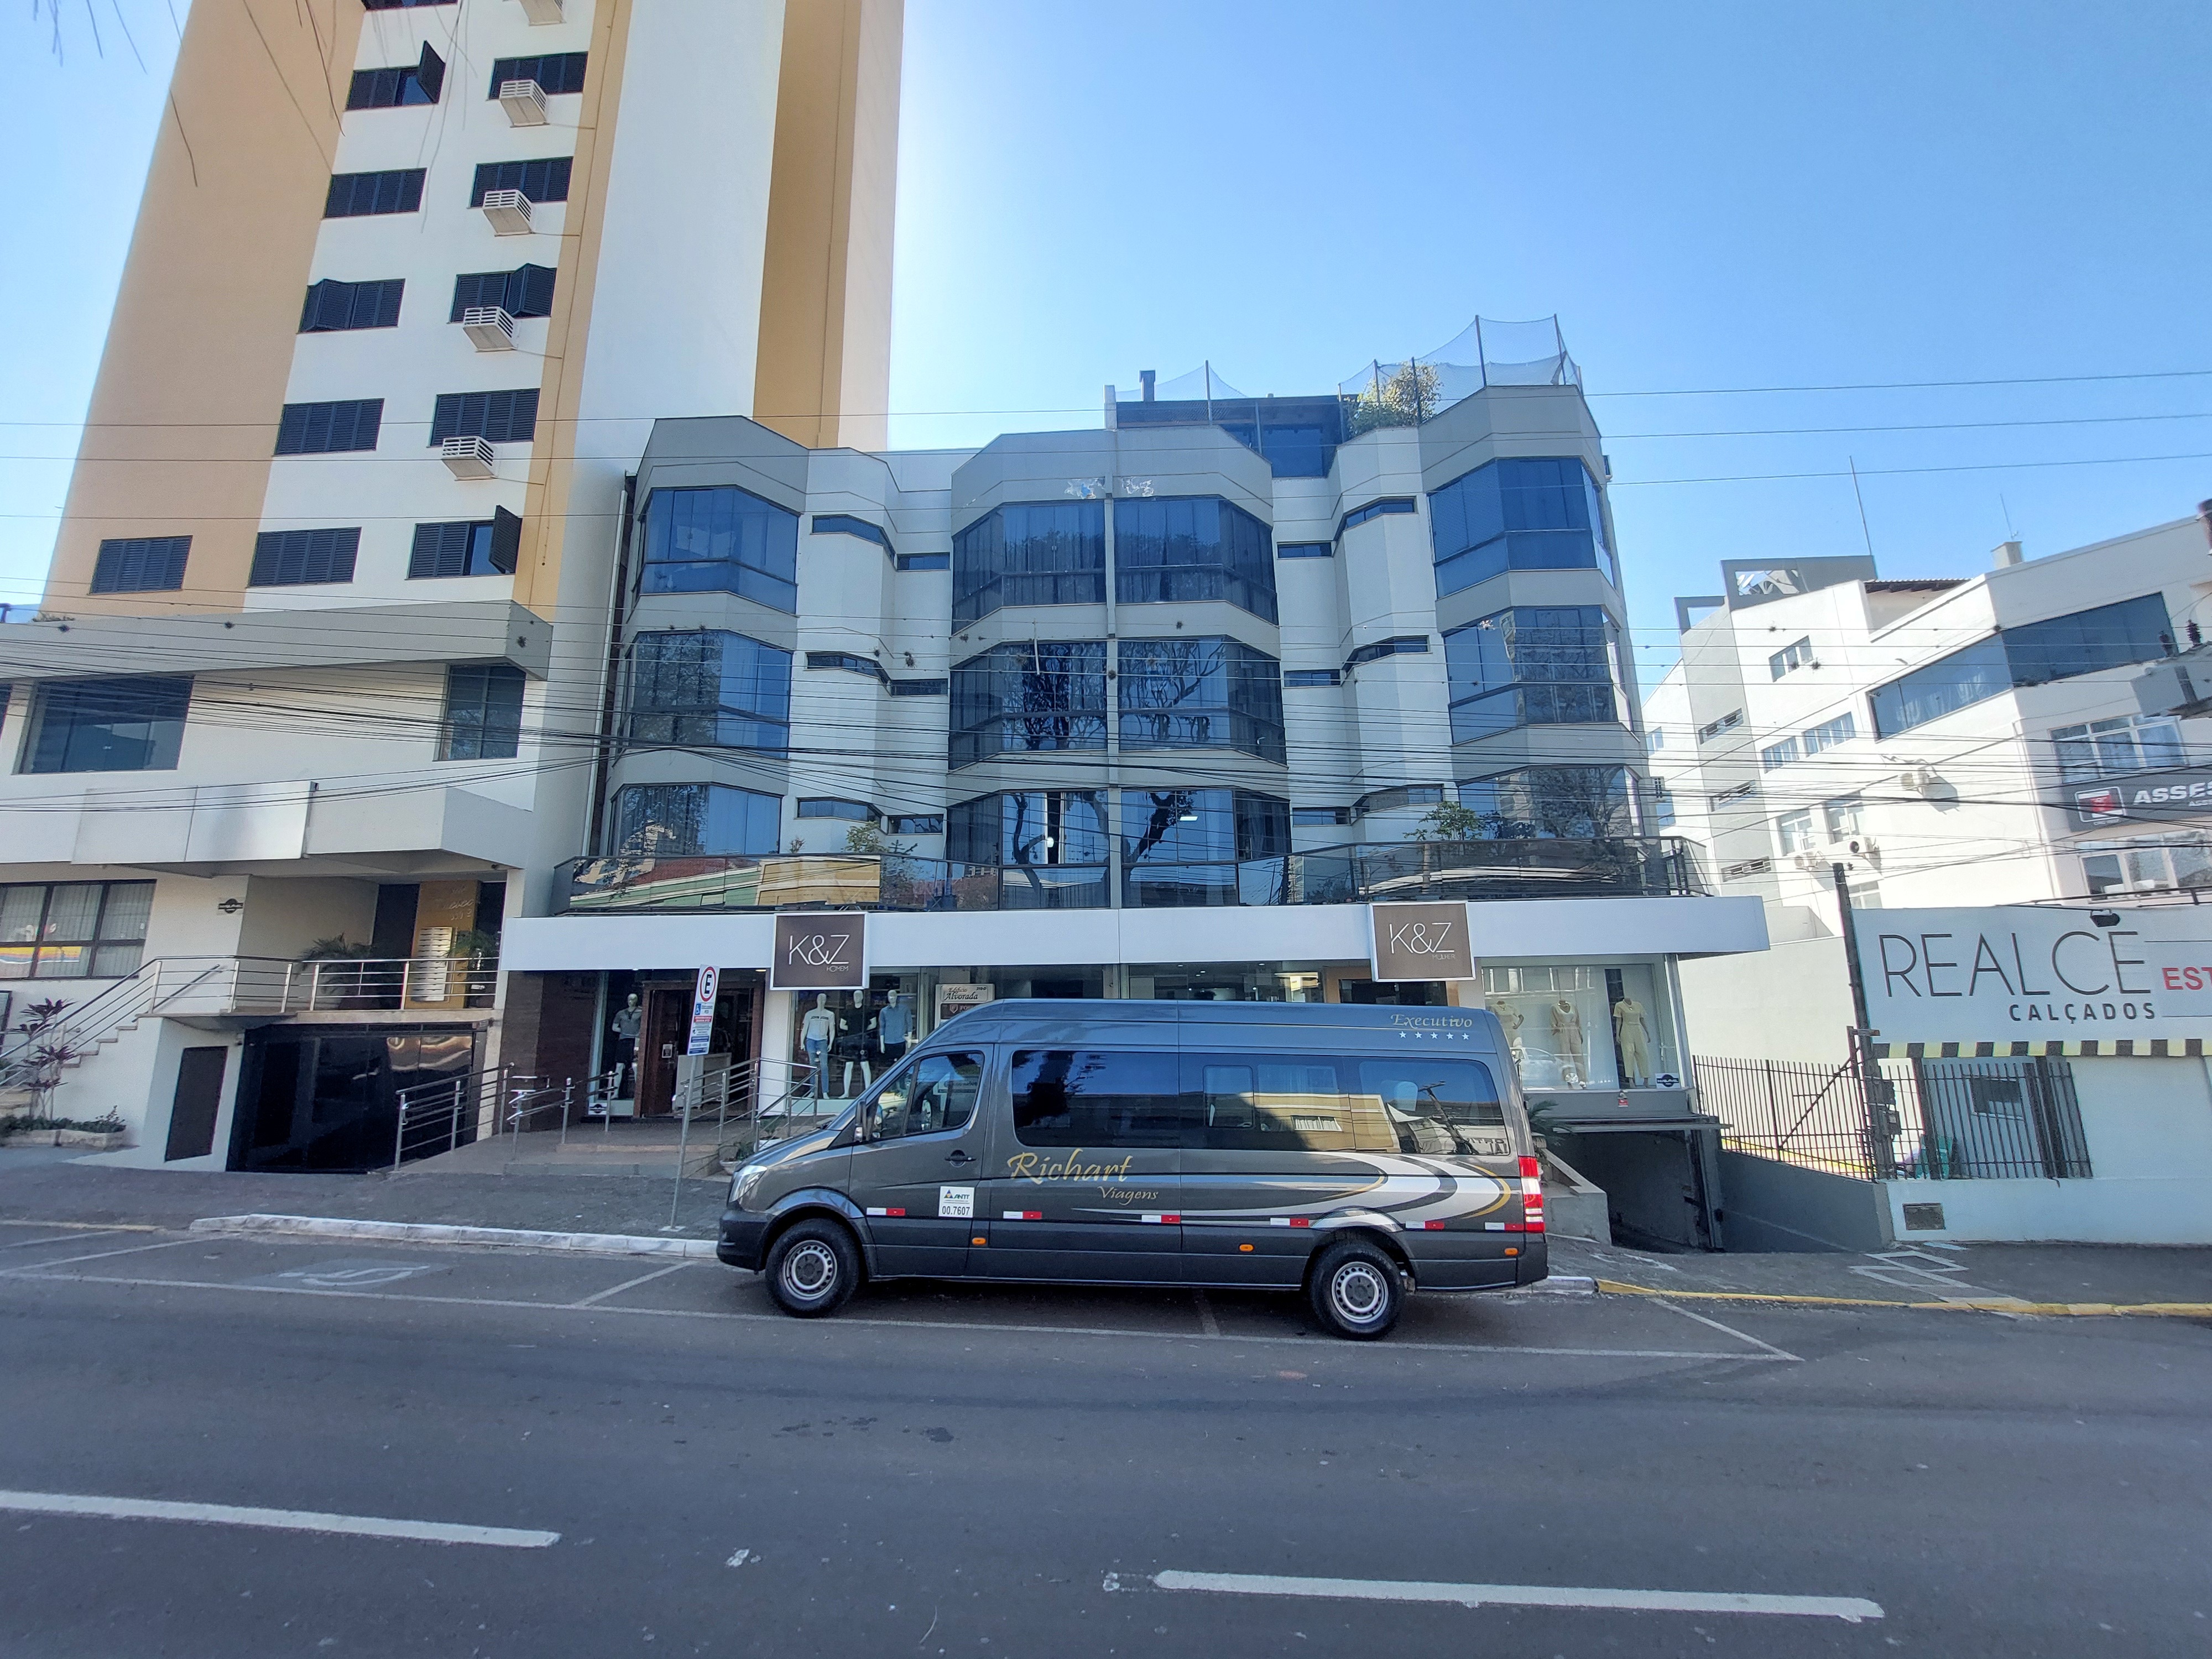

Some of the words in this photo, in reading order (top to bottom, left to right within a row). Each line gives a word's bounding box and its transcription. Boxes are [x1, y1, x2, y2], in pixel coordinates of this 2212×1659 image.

[1389, 922, 1455, 954] K&Z
[789, 935, 850, 966] K&Z
[1879, 931, 2152, 998] REALCE
[704, 974, 712, 994] E
[944, 992, 978, 1001] Alvorada
[1390, 1014, 1473, 1029] Executivo
[2008, 1003, 2156, 1024] CALÇADOS
[1007, 1147, 1133, 1185] Richart
[1097, 1186, 1159, 1205] Viagens
[942, 1206, 970, 1215] 00.7607
